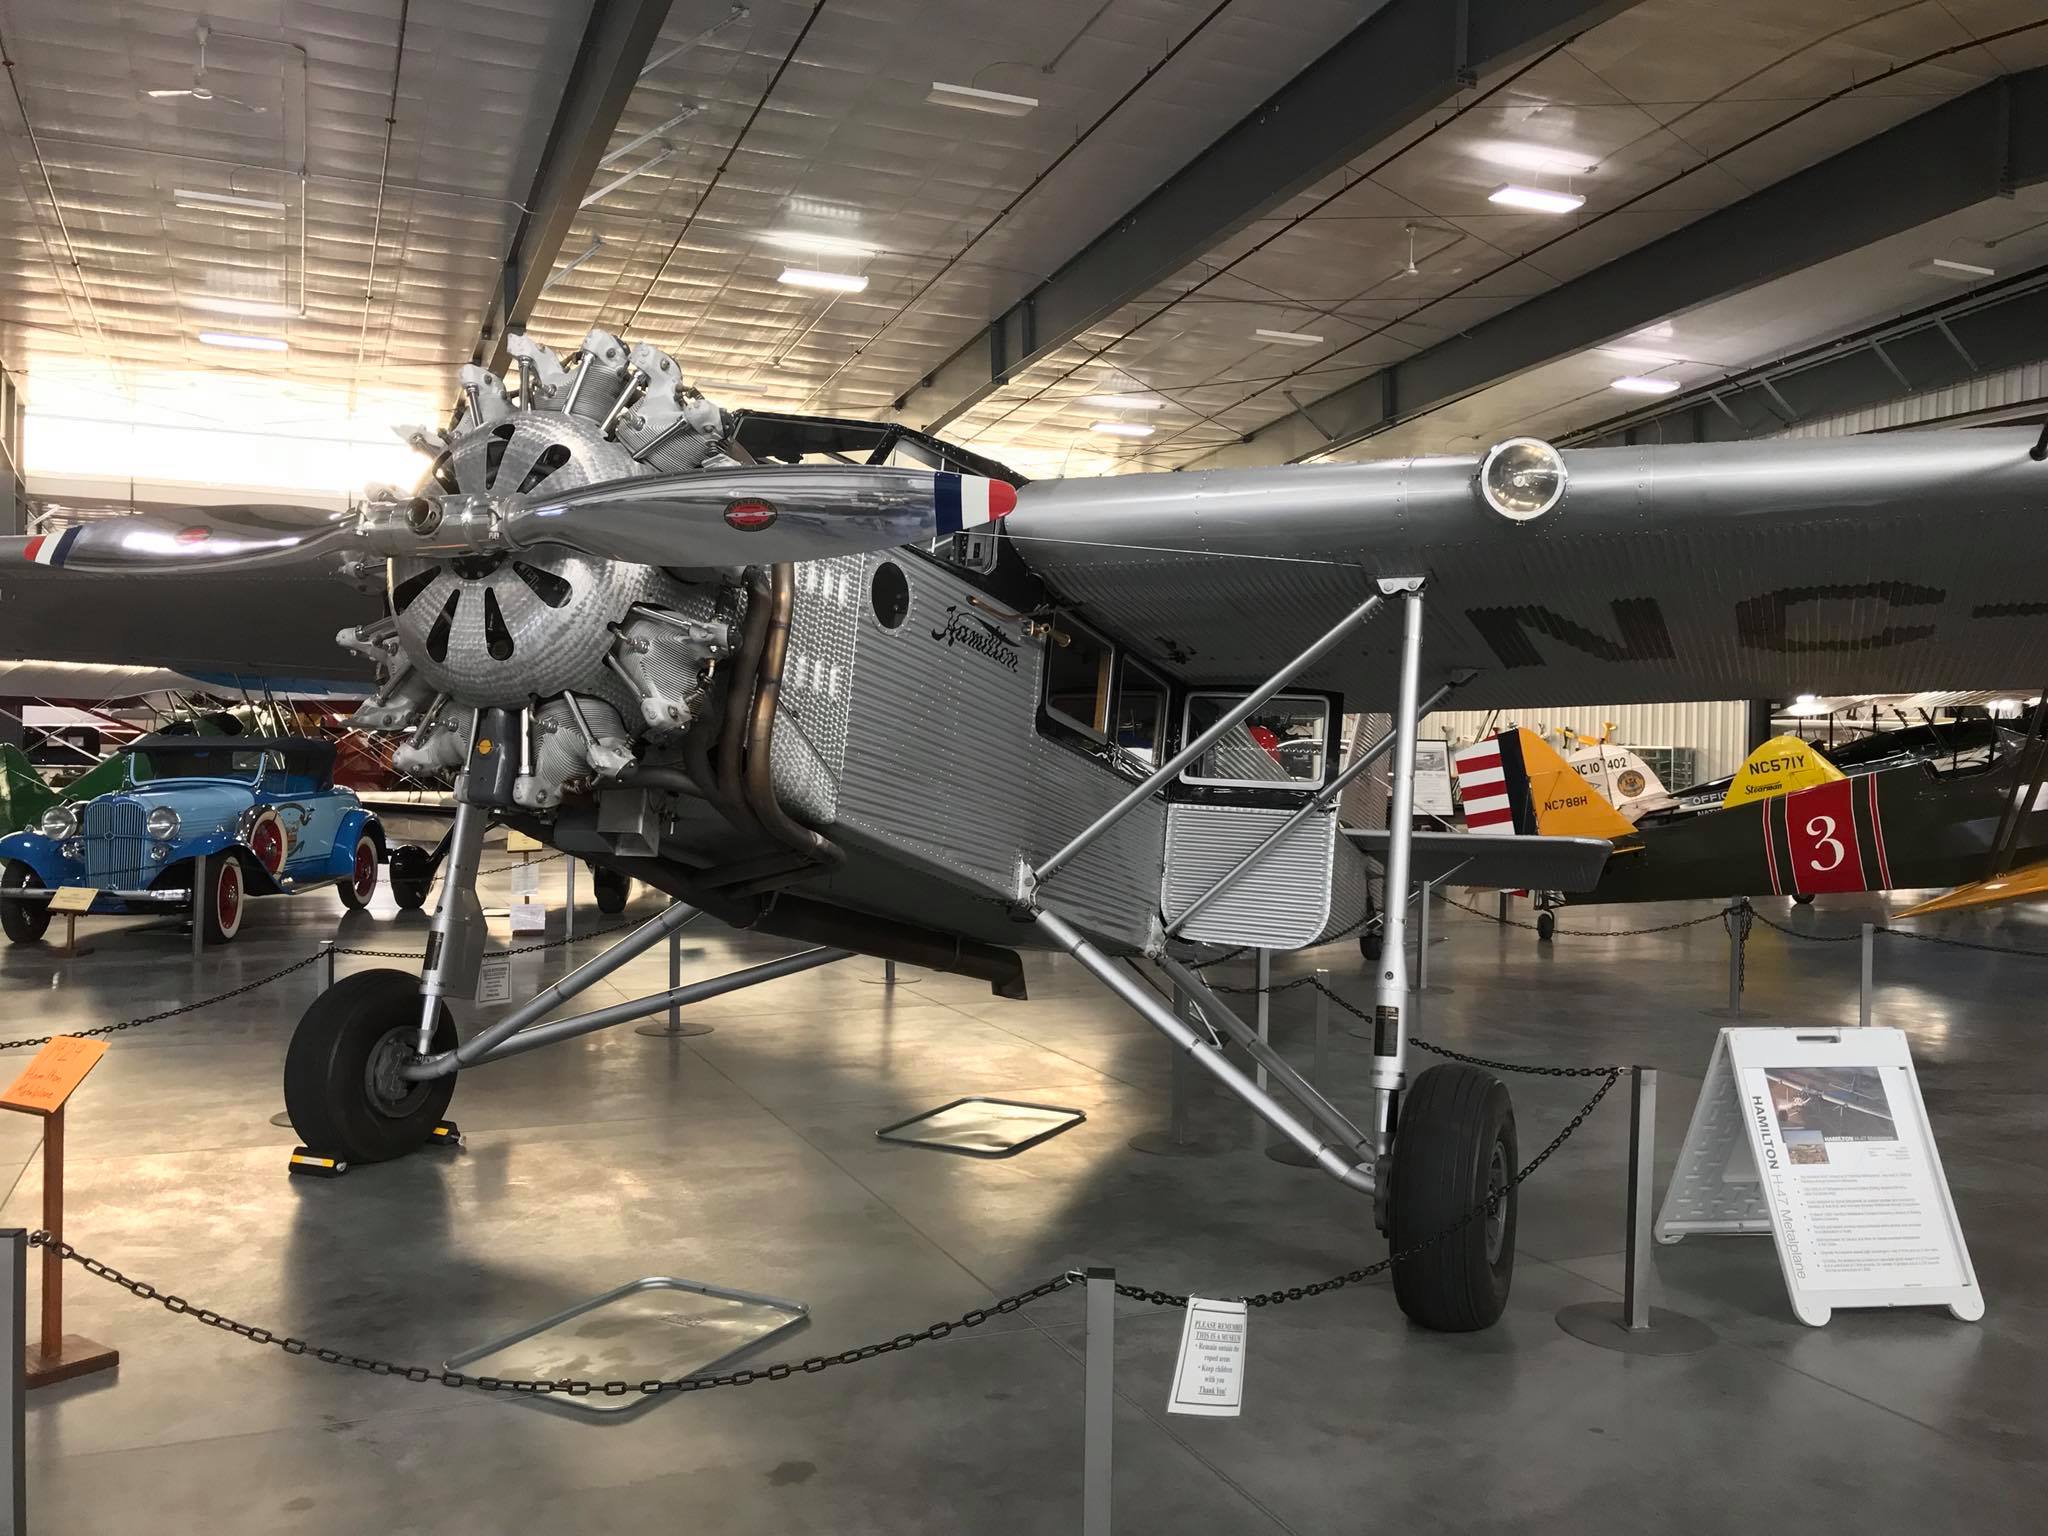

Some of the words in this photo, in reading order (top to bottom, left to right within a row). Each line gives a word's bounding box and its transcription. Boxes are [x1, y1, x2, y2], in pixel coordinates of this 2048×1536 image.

[1749, 755, 1805, 776] NC571Y
[1745, 781, 1782, 795] Stearman
[1544, 796, 1588, 811] NC788H
[1806, 815, 1845, 871] 3
[1752, 1095, 1780, 1170] HAMILTON
[1780, 1209, 1806, 1280] Metalplane
